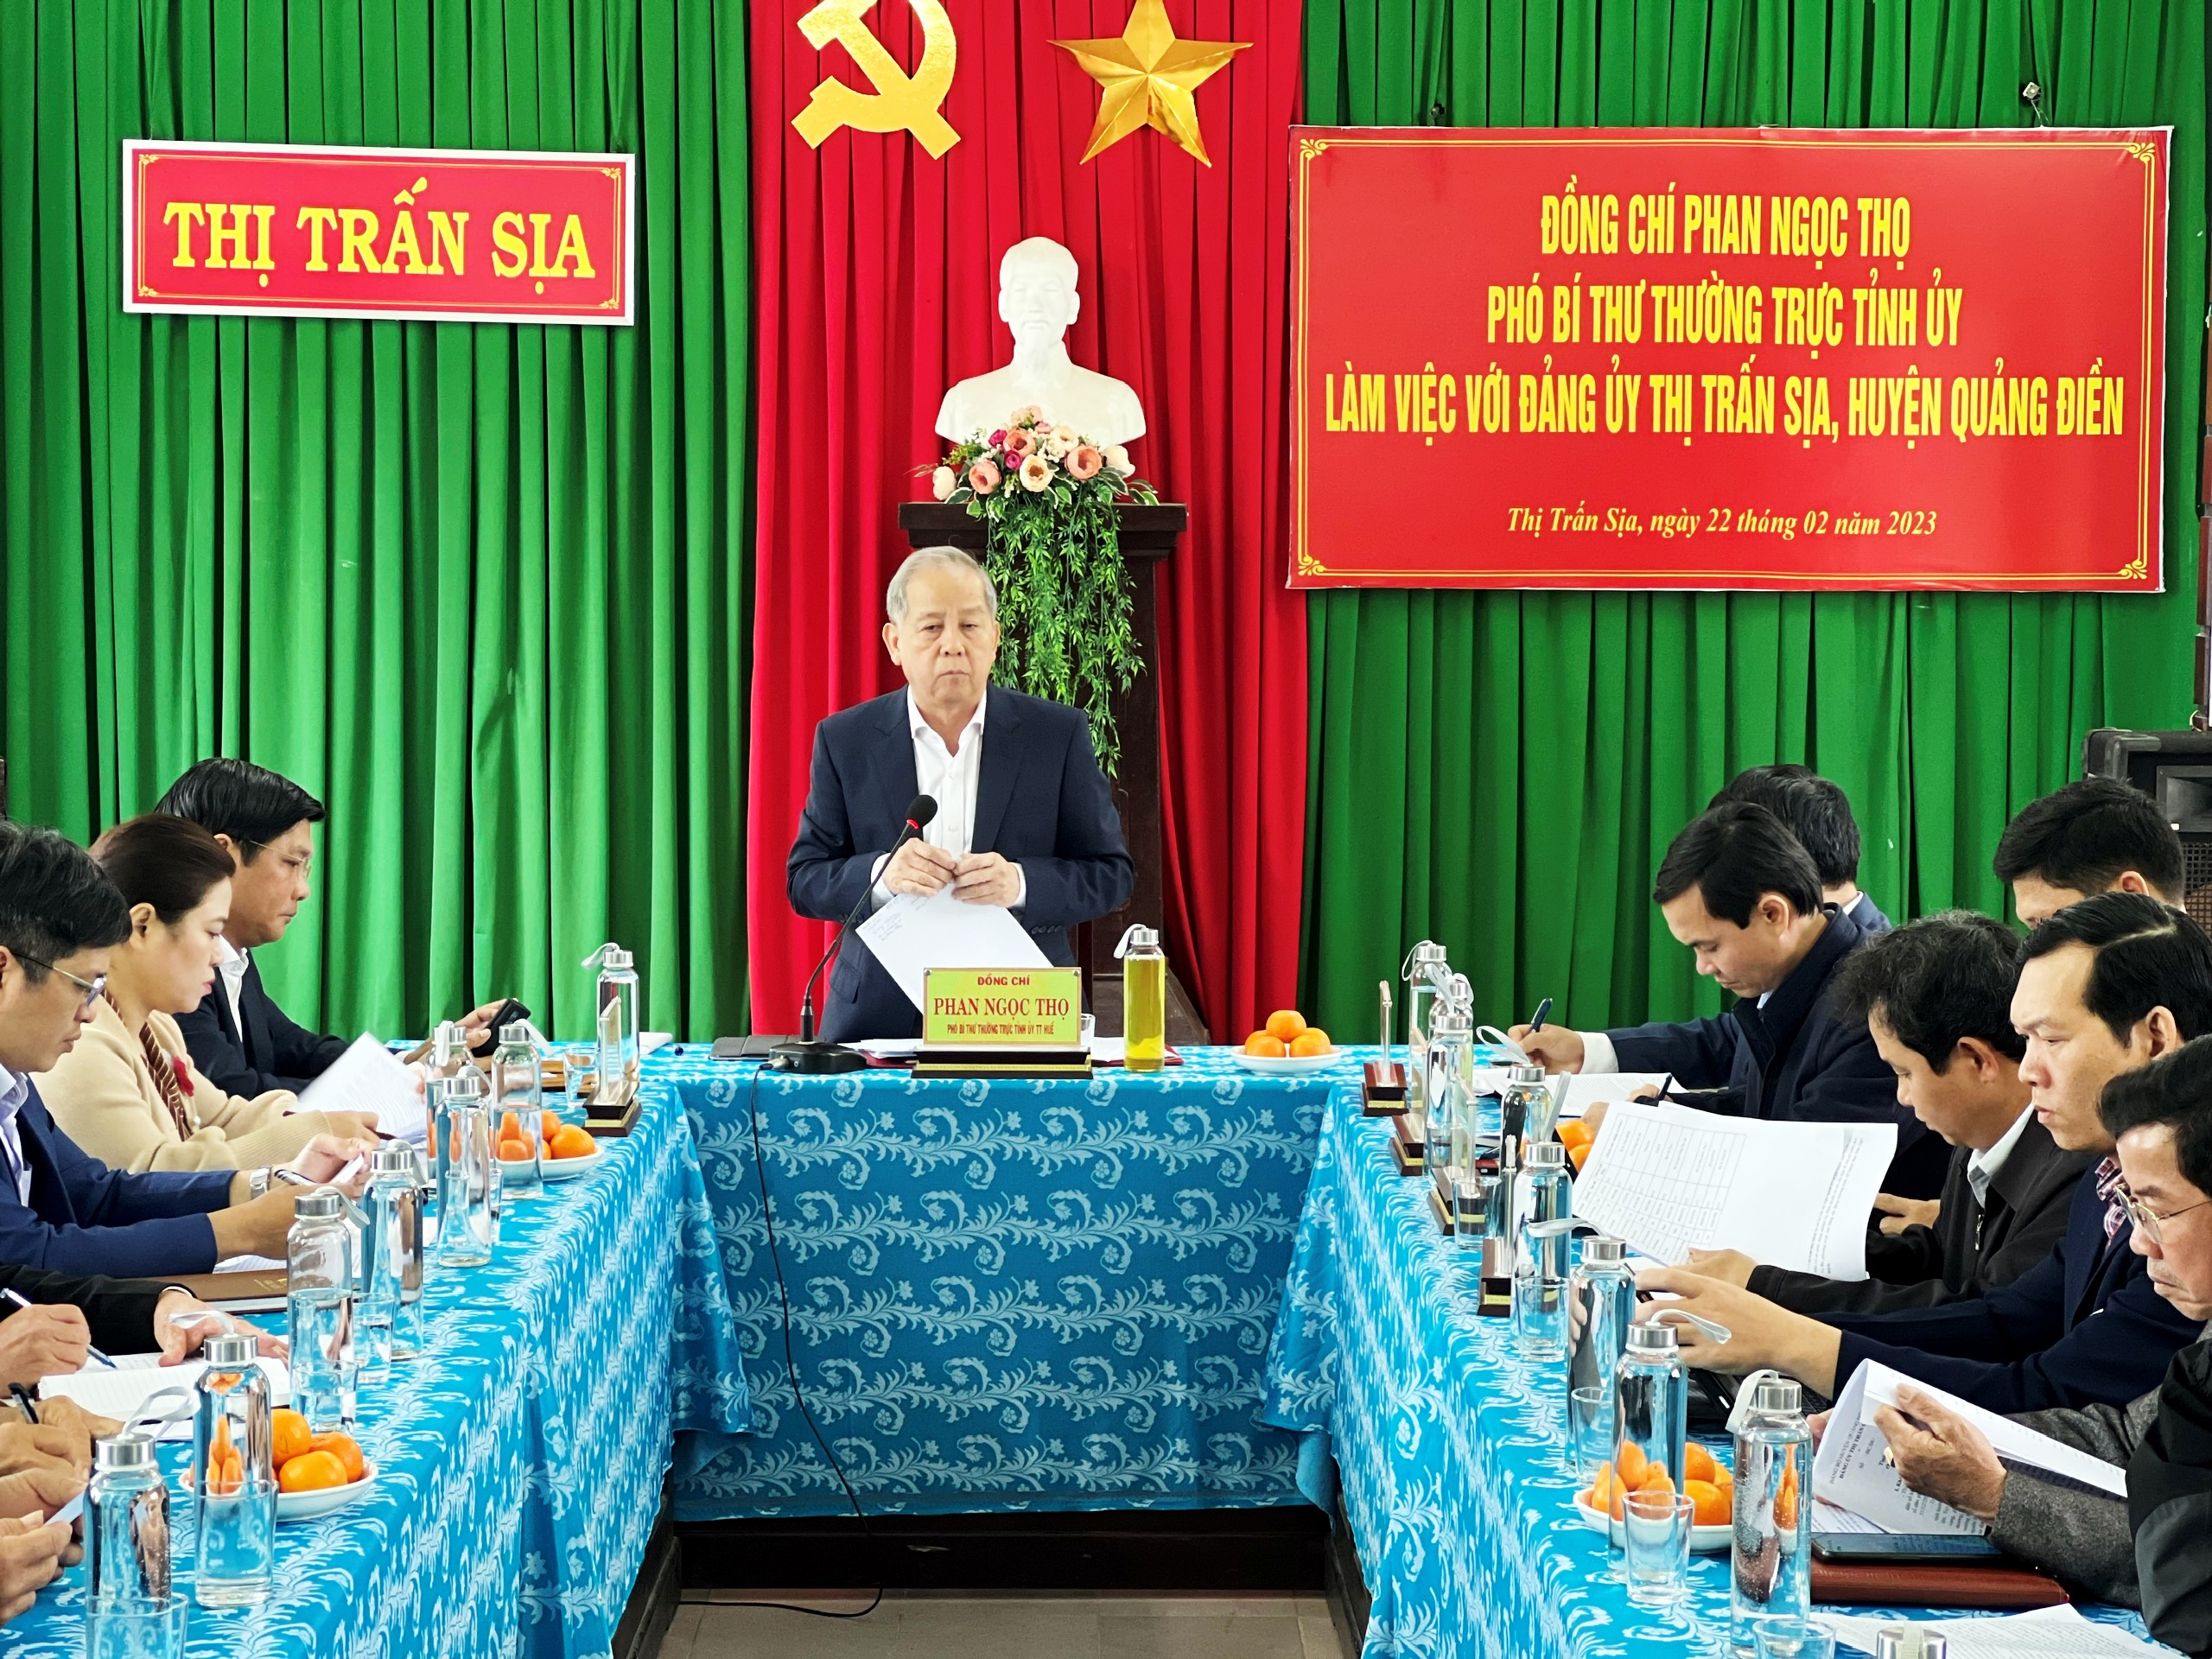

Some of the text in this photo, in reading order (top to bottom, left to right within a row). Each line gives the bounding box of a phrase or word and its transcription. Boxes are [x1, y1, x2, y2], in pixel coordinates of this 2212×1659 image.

[163, 176, 596, 296] THỊ TRẤN SỊA
[1541, 175, 1910, 270] ĐỒNG CHÍ PHAN NGỌC THỌ
[1487, 267, 1963, 360] PHÓ BÍ THƯ THƯỜNG TRỰC TỈNH ỦY
[1325, 353, 2124, 449] LÀM VIỆC VỚI ĐẢNG ỦY THỊ TRẤN SỊA, HUYỆN QUẢNG ĐIỀN
[1508, 500, 1937, 541] Thị Trấn Sịa, ngày 22 tháng 02 năm 2023
[934, 998, 1070, 1020] PHAN NGỌC THỌ
[977, 973, 1030, 986] ĐỒNG CHÍ
[1036, 1024, 1042, 1034] TT
[1044, 1021, 1055, 1034] HUẾ
